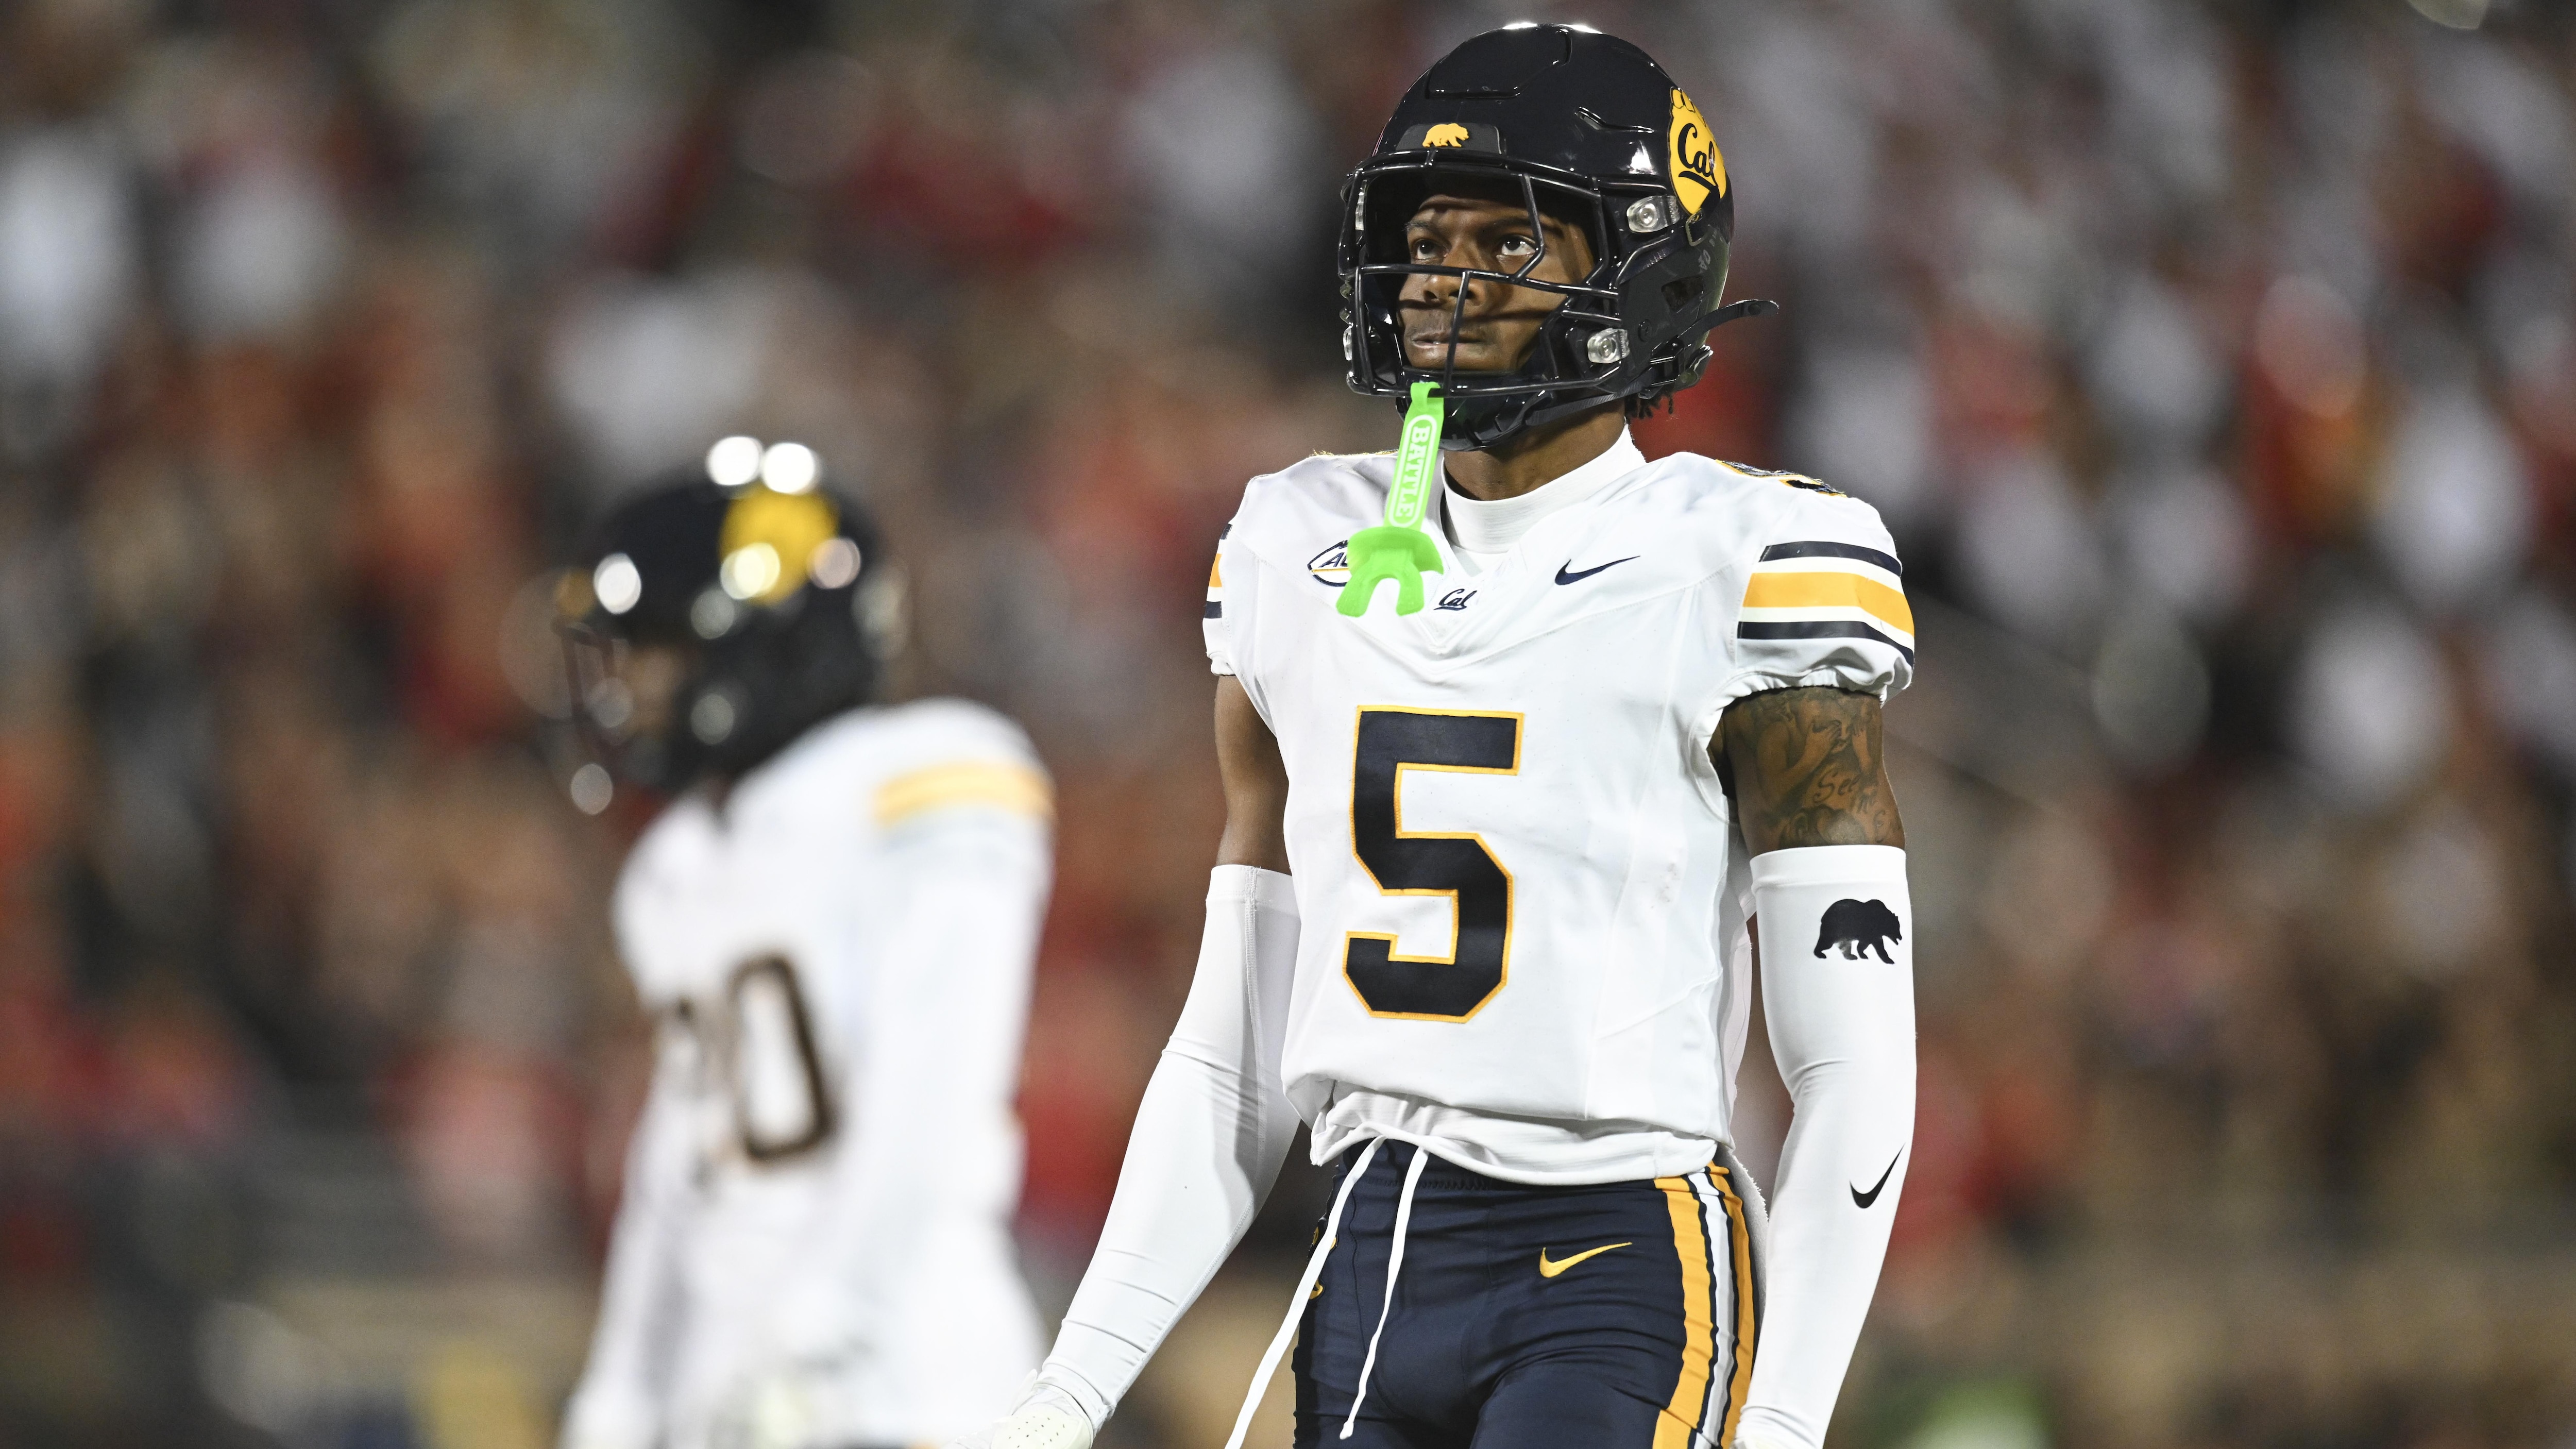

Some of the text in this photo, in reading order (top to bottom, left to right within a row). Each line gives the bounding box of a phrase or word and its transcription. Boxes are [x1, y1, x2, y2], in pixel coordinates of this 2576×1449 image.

[1677, 123, 1719, 189] Cal
[1395, 426, 1431, 517] BATTLE
[1433, 588, 1478, 611] Cal
[1342, 705, 1524, 1024] 5
